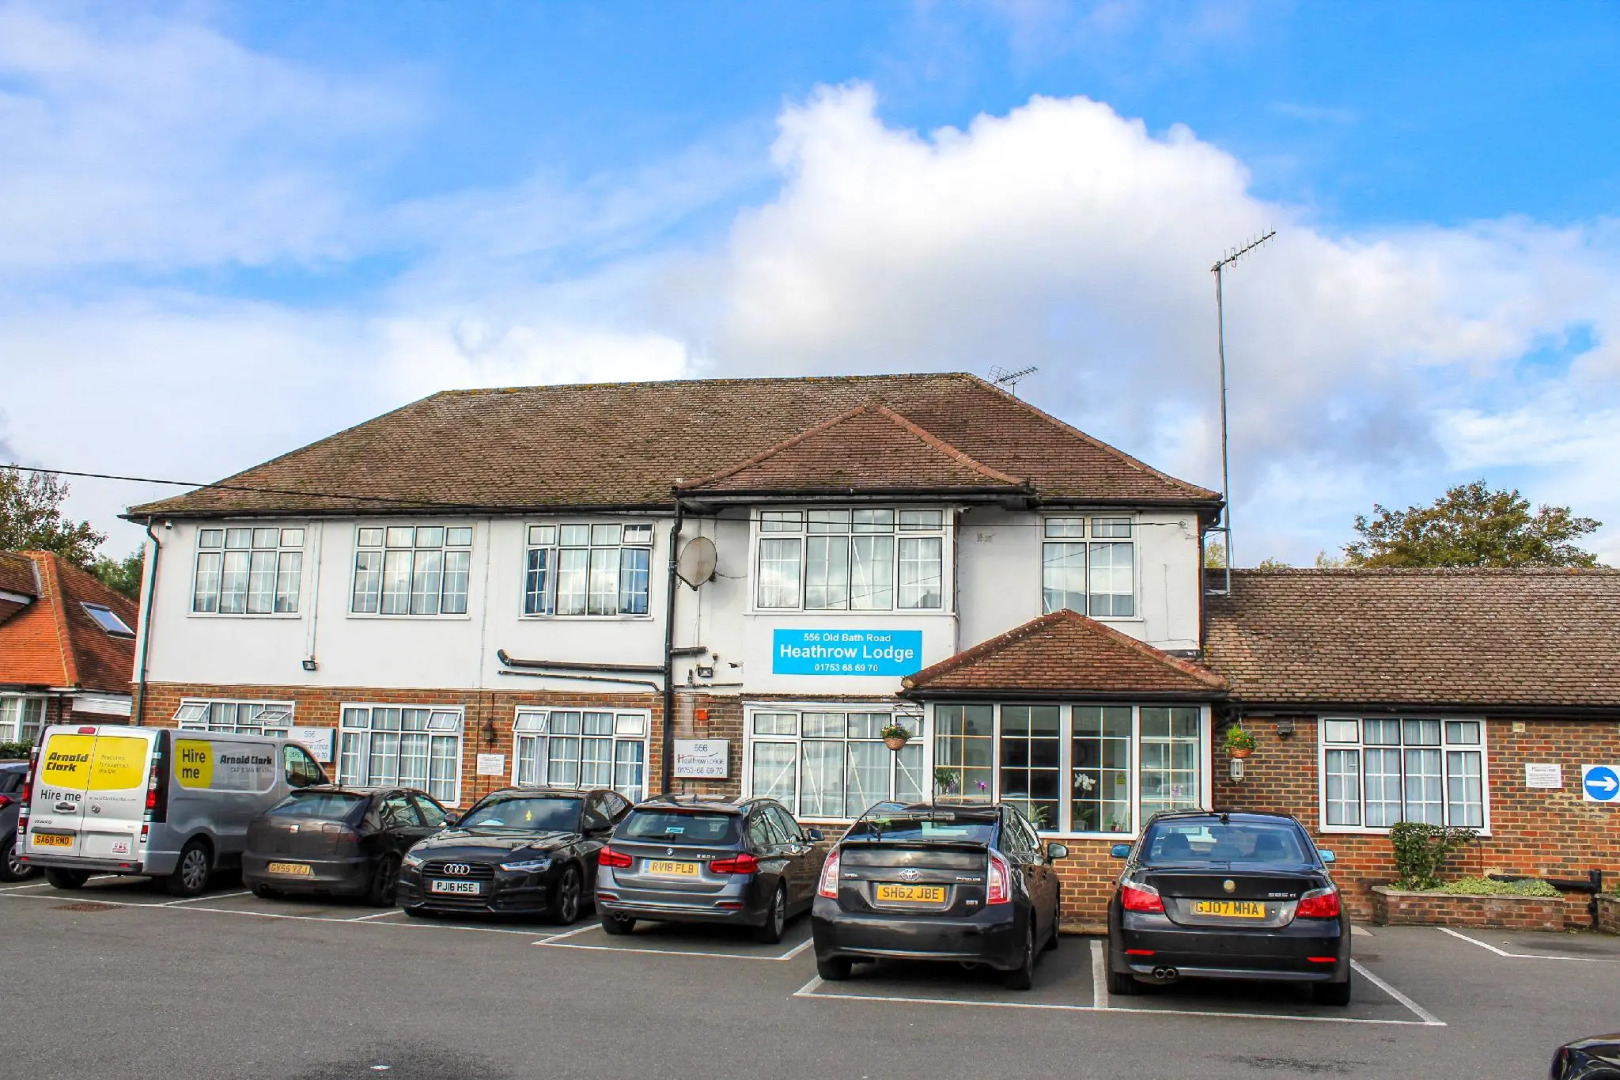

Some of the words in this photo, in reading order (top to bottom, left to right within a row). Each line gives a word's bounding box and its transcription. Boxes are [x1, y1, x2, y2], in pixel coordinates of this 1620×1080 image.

[803, 633, 820, 641] 556
[822, 633, 839, 642] Old
[842, 633, 863, 642] Bath
[867, 634, 891, 642] Road
[780, 644, 858, 659] Heathrow
[862, 645, 914, 663] Lodge
[855, 664, 866, 672] 69
[868, 664, 878, 672] 70
[694, 744, 708, 752] 556
[49, 753, 89, 762] Arnold
[182, 749, 207, 764] Hire
[220, 755, 250, 764] Arnold
[251, 756, 272, 765] Clark
[46, 762, 77, 772] Clark
[182, 768, 200, 779] me
[40, 789, 61, 801] Hire
[65, 793, 82, 802] me
[437, 882, 455, 891] PJ16
[457, 883, 475, 892] HSE
[883, 887, 913, 898] SH62
[917, 888, 940, 900] JBE
